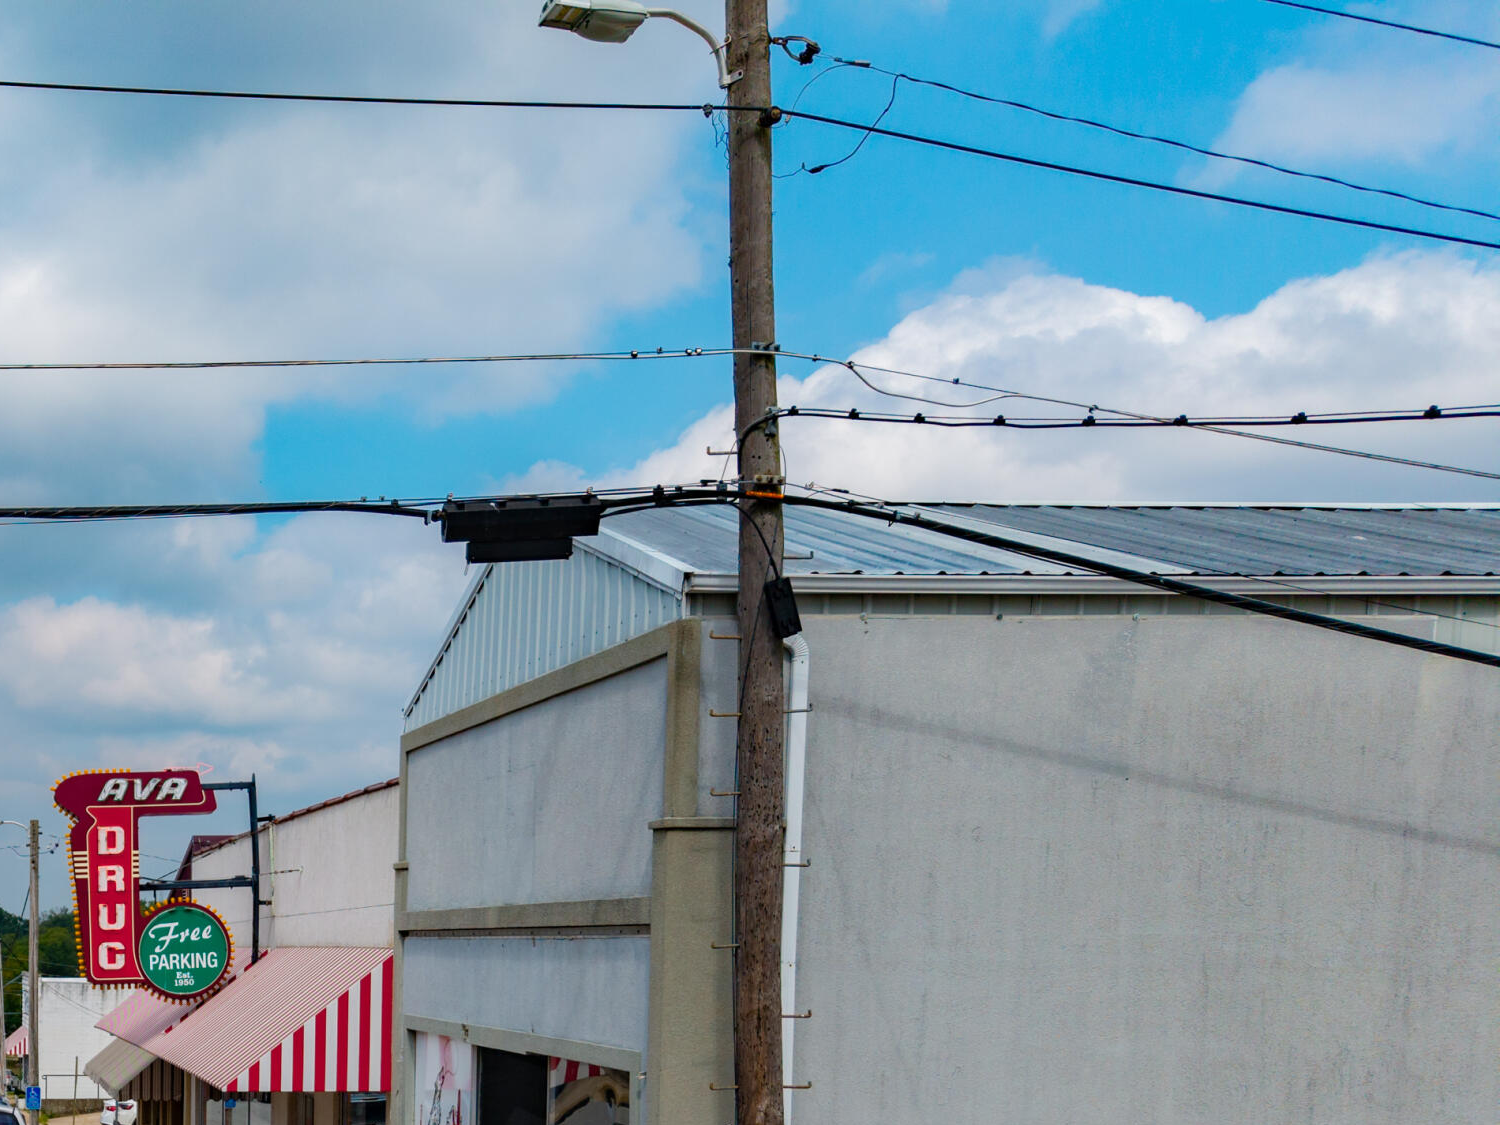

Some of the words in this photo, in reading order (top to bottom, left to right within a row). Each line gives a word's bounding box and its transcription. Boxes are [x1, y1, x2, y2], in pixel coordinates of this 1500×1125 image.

[97, 778, 188, 801] AVA
[97, 826, 126, 970] DRUG
[148, 921, 212, 953] Free
[149, 952, 218, 970] PARKING
[174, 978, 195, 987] 1950
[176, 971, 194, 979] Est.
